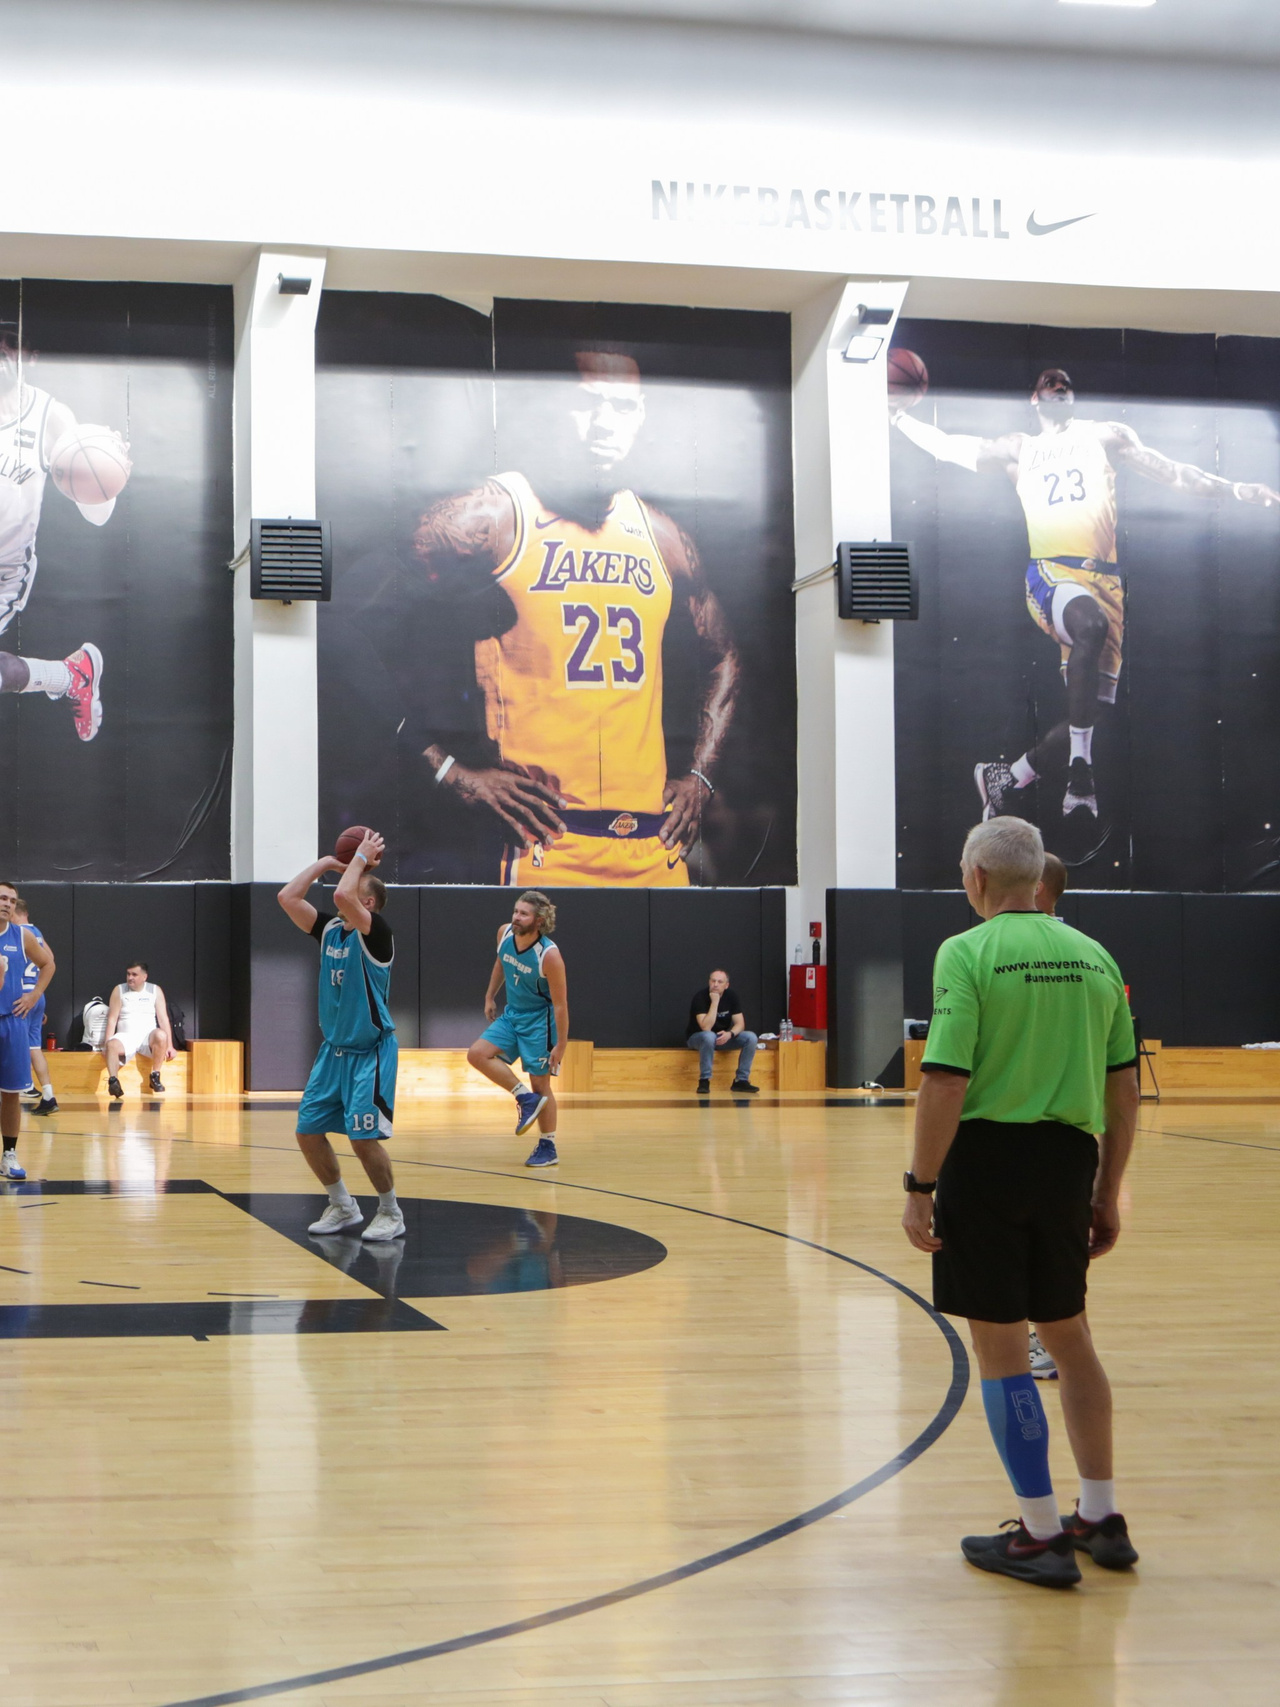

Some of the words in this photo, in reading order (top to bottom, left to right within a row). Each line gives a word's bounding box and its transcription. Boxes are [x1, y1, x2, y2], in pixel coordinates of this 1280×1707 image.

[1043, 468, 1086, 506] 23
[529, 540, 656, 596] LAKERS
[562, 602, 646, 690] 23
[994, 959, 1105, 975] www.unevents.ru
[512, 973, 520, 986] 7
[1024, 973, 1083, 983] #unevents
[538, 1057, 548, 1069] 7
[352, 1113, 375, 1131] 18
[1011, 1389, 1042, 1441] RUS
